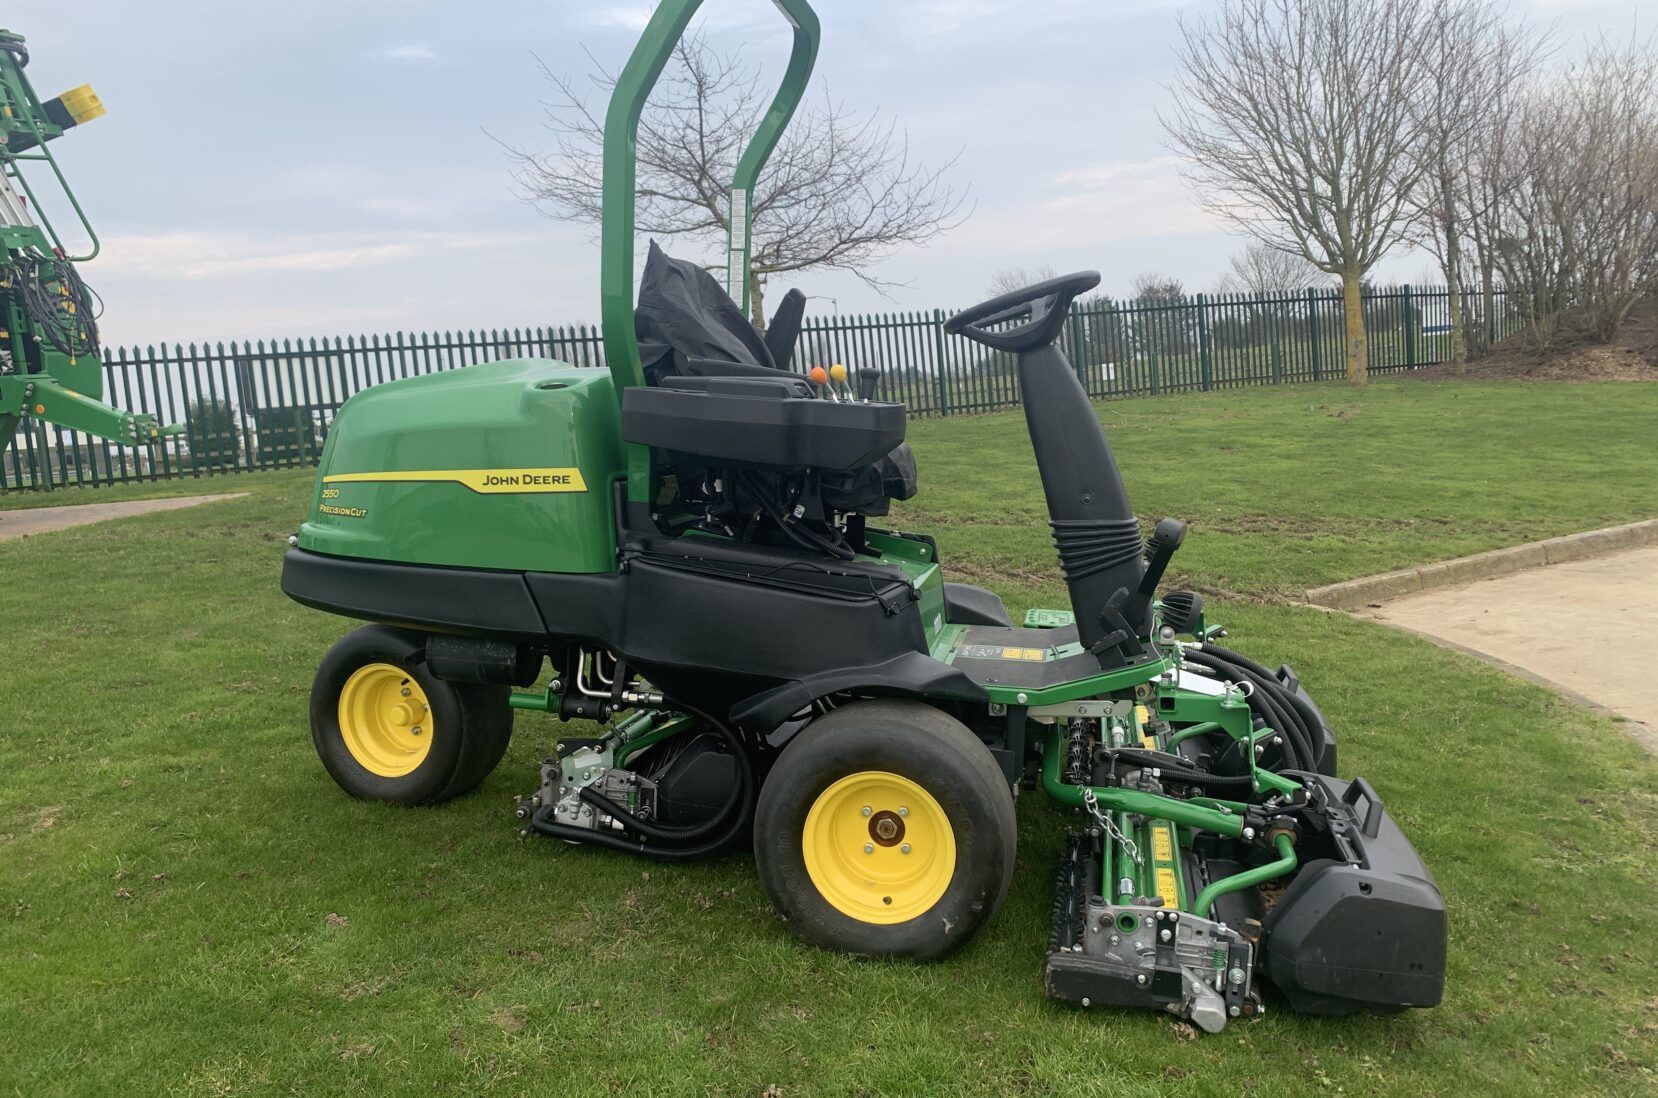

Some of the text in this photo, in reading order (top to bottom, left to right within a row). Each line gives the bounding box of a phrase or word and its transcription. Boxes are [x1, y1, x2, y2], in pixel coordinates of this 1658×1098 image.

[482, 474, 571, 486] JOHN DEERE
[321, 488, 340, 499] 2550
